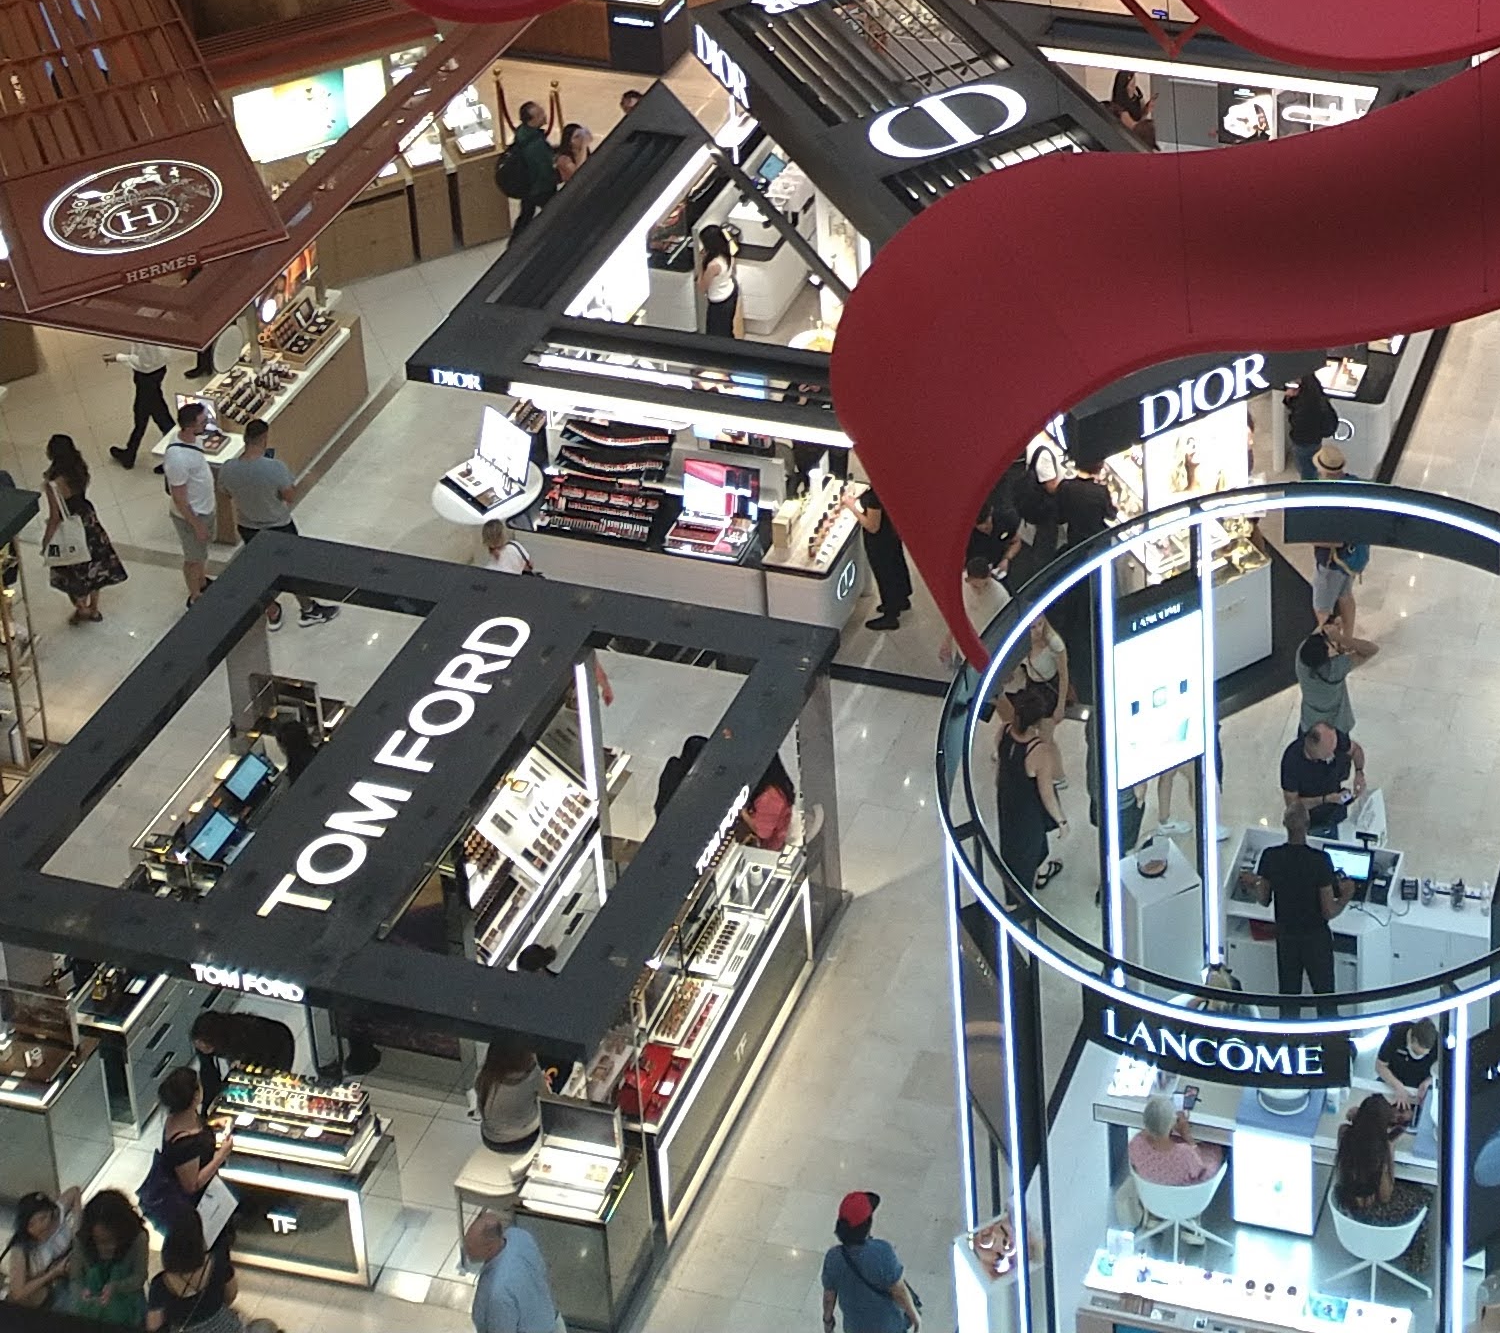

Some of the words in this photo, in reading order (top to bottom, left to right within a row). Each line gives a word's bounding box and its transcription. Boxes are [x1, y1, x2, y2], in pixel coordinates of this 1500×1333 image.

[694, 24, 750, 110] DIOR
[432, 368, 482, 391] DIOR
[1139, 353, 1271, 439] DIOR
[256, 782, 413, 917] TOM
[375, 616, 533, 774] FORD
[695, 829, 721, 876] TOM
[719, 784, 750, 839] FORD
[190, 963, 240, 989] TOM
[242, 973, 305, 1002] FORD
[1103, 1006, 1325, 1078] LANCÔME
[266, 1213, 297, 1235] TF
